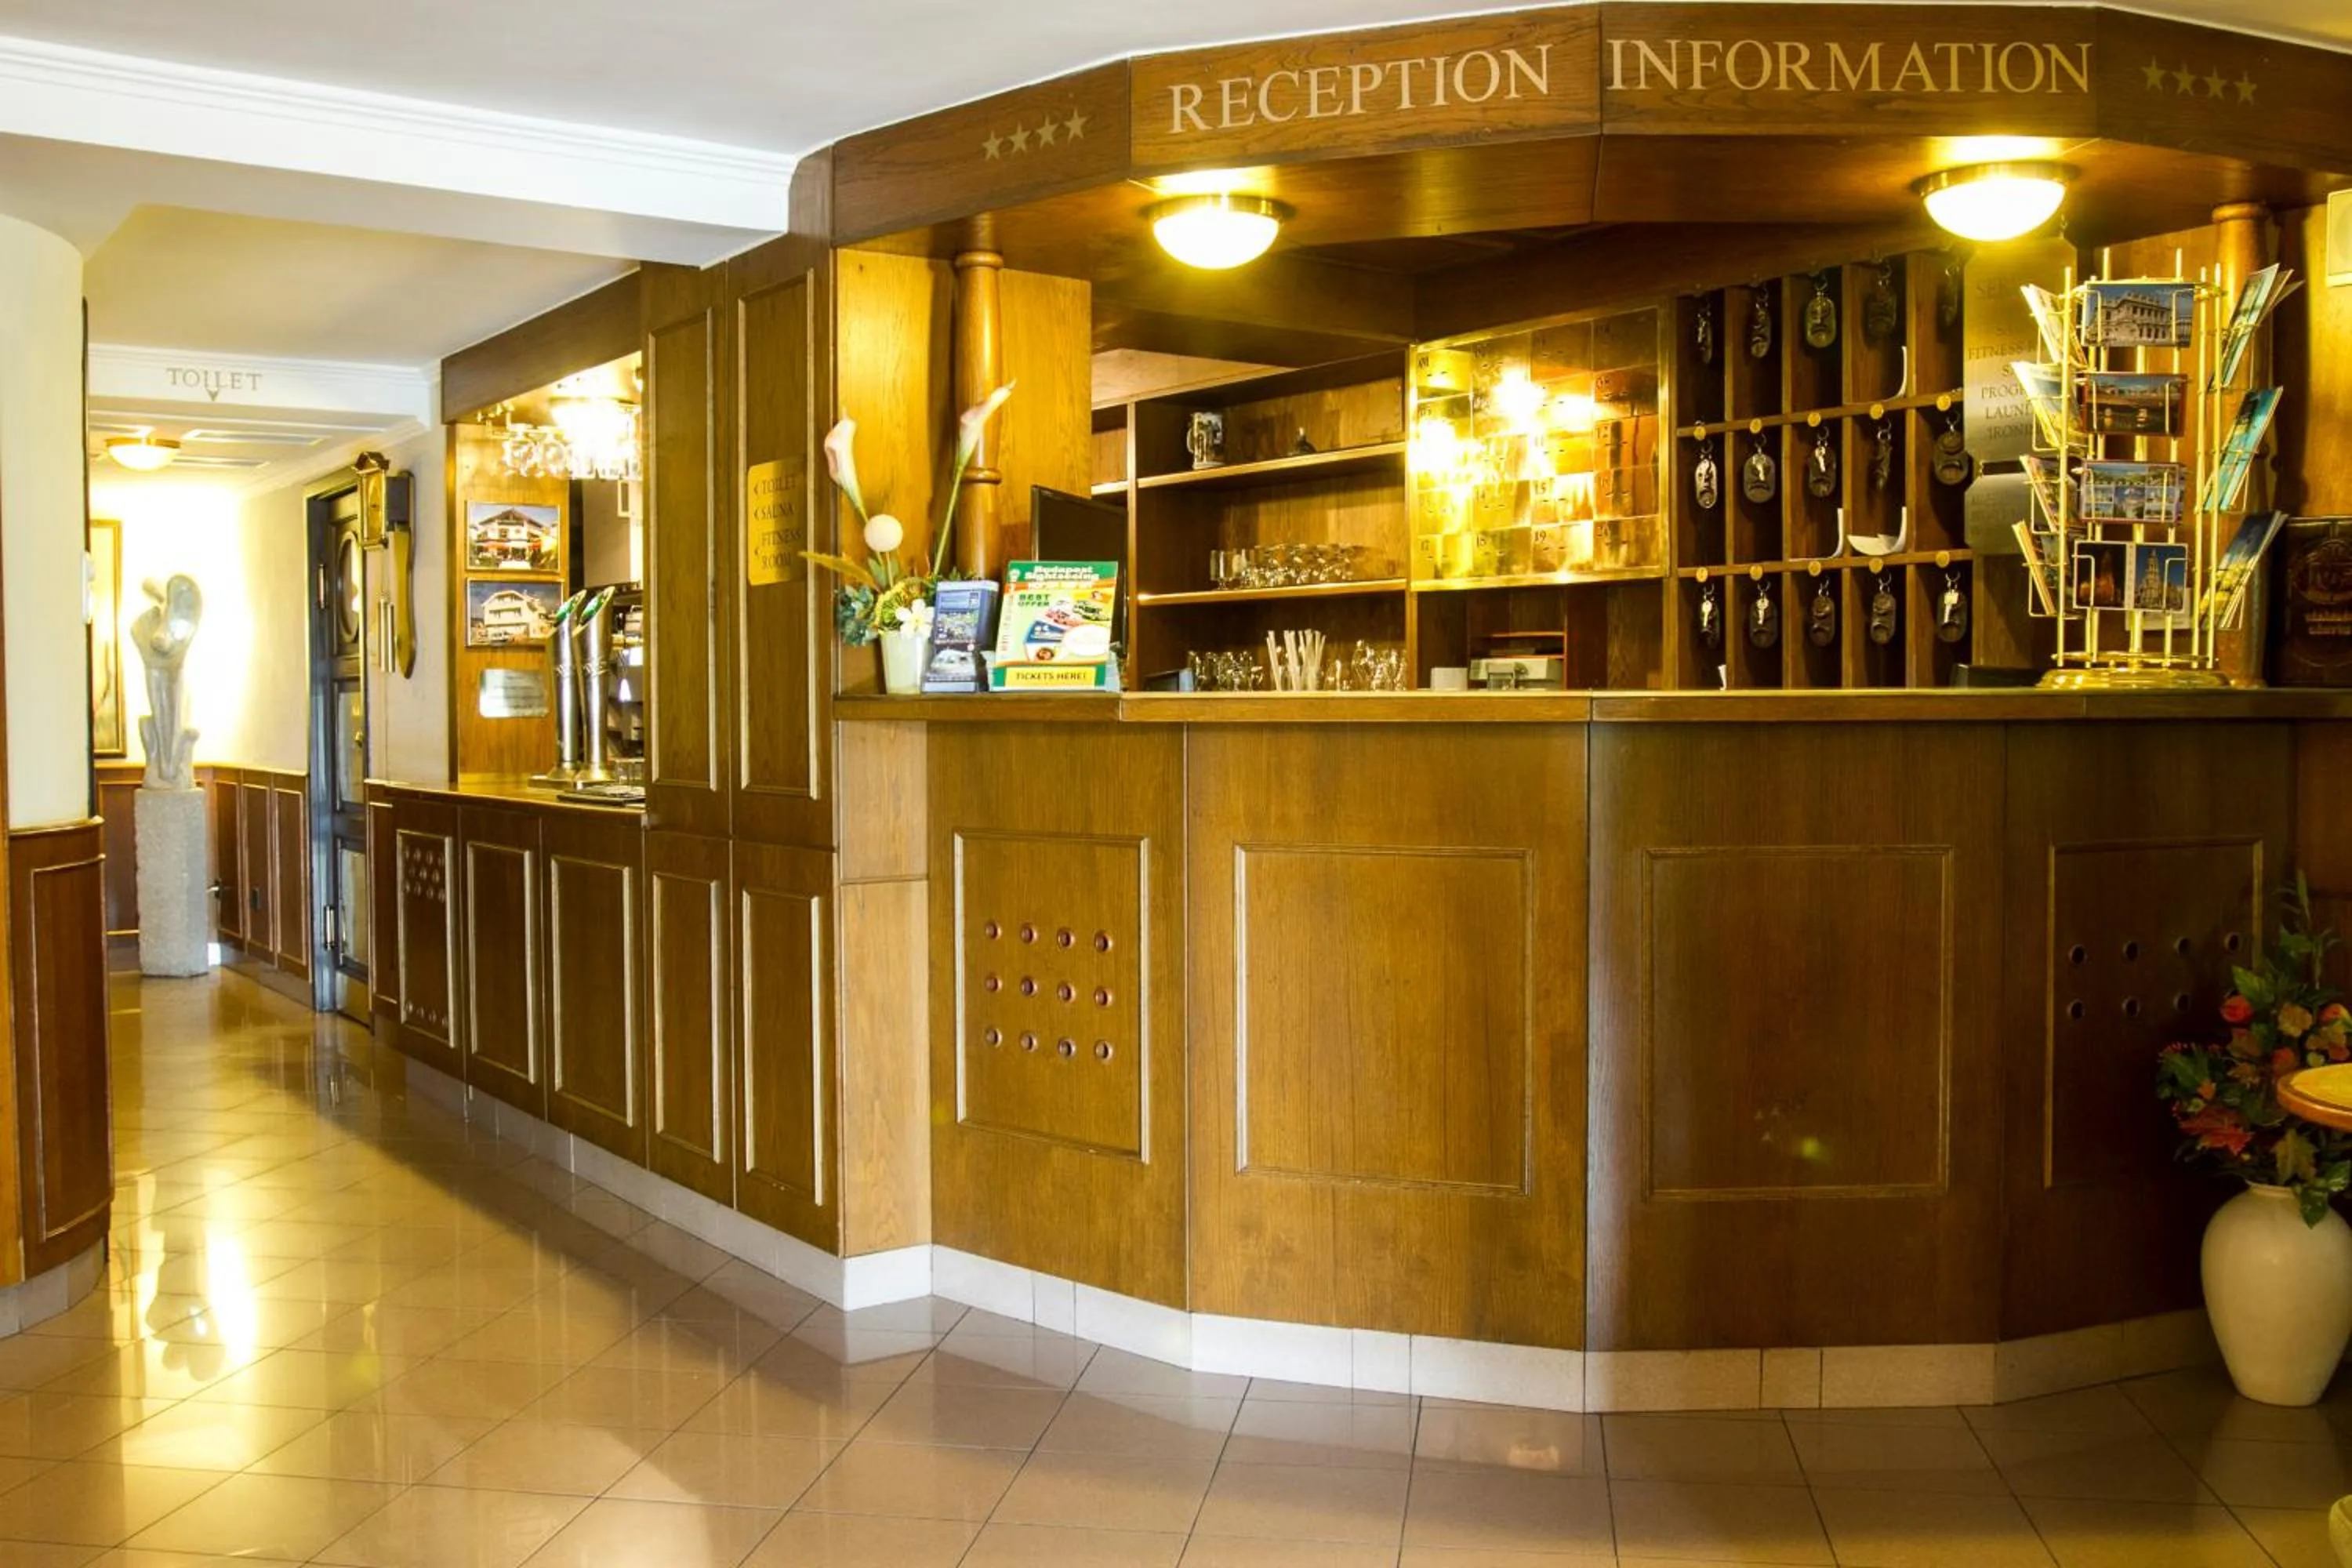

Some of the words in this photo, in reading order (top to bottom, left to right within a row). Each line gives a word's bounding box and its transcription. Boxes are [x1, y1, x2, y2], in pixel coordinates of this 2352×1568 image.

[1606, 38, 2094, 93] INFORMATION
[1168, 45, 1554, 134] RECEPTION
[1968, 339, 2024, 361] FITNESS
[166, 367, 263, 391] TOILET
[1986, 403, 2033, 419] LAUND
[761, 474, 796, 495] TOILET
[1534, 482, 1547, 495] 15
[761, 501, 794, 520] SAUNA
[761, 528, 803, 546] FITNESS
[1534, 530, 1547, 543] 19
[762, 551, 792, 569] ROOM
[1016, 671, 1054, 681] TICKETS
[1056, 671, 1087, 680] HERE!
